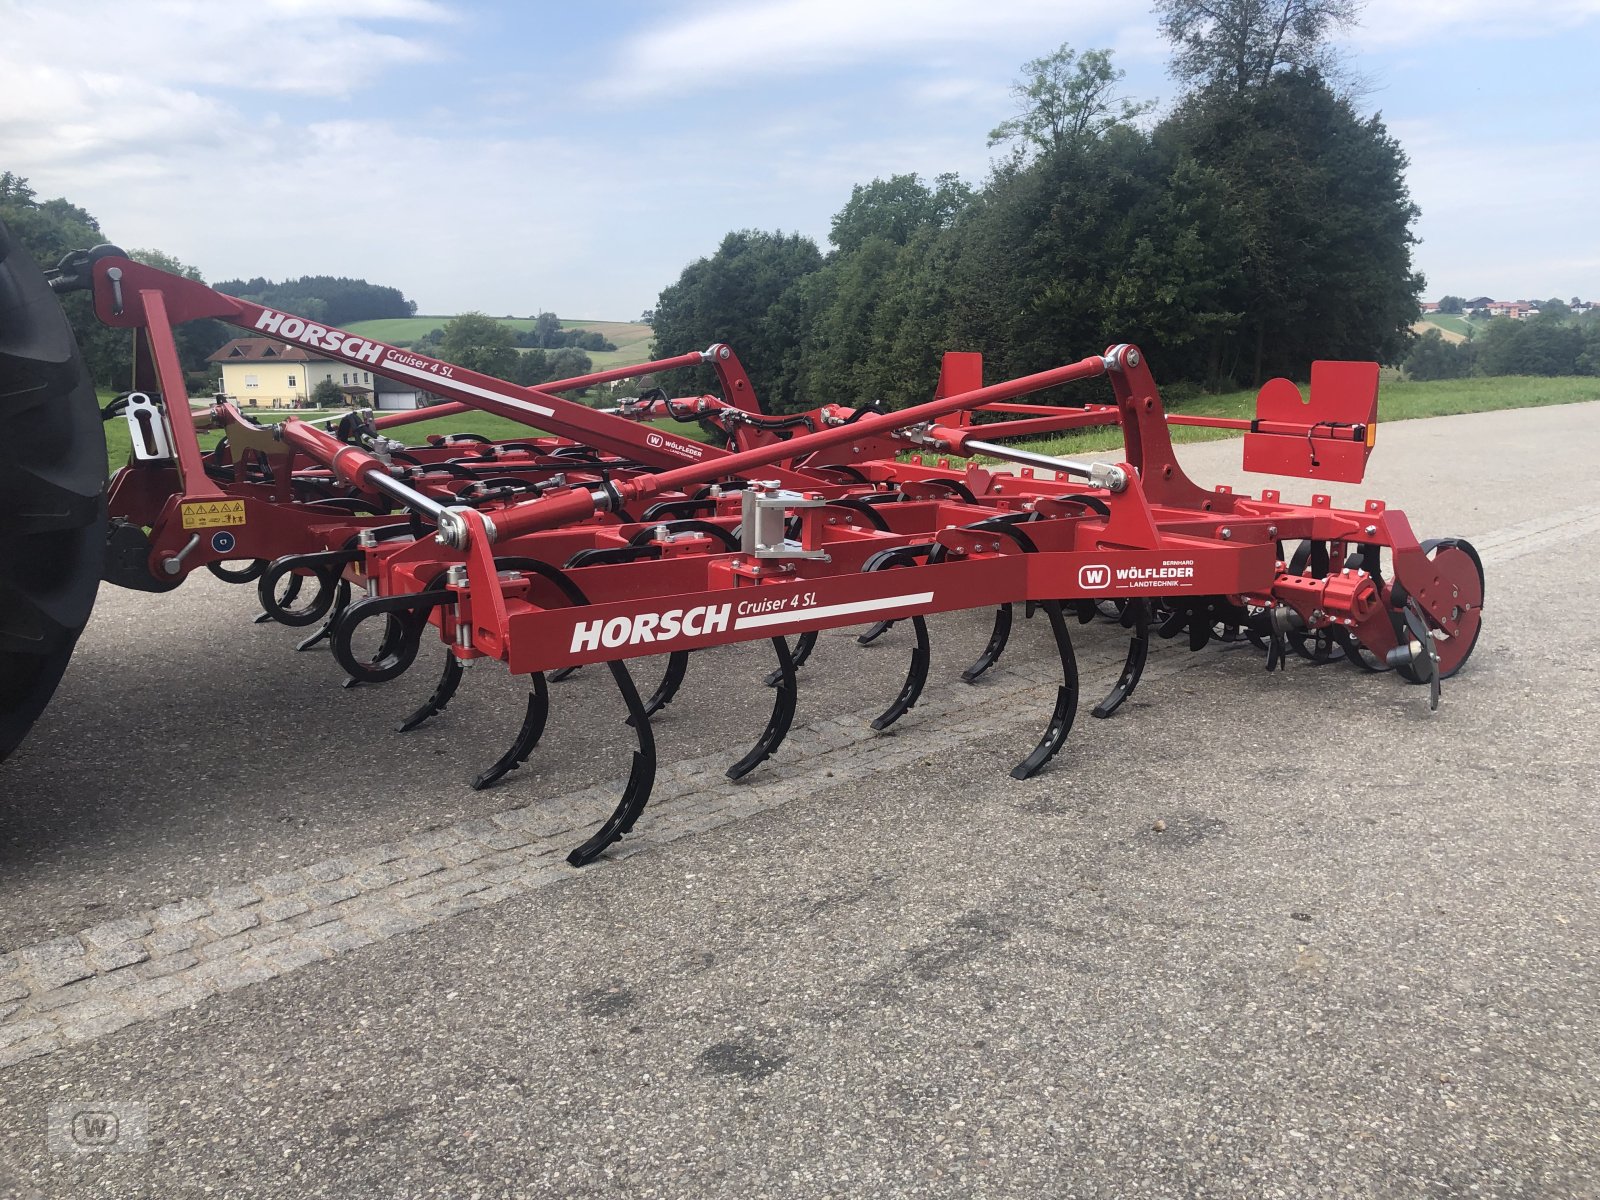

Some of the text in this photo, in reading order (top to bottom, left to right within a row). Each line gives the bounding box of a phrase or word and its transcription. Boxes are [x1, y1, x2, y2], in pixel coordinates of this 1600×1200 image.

[255, 309, 454, 378] HORSCH Cruiser 4 SL
[1086, 570, 1103, 584] W
[1116, 566, 1194, 580] WÖLFLEDER
[1129, 580, 1179, 588] LANDTECHNIK
[569, 592, 817, 653] HORSCH Cruiser 4 SL
